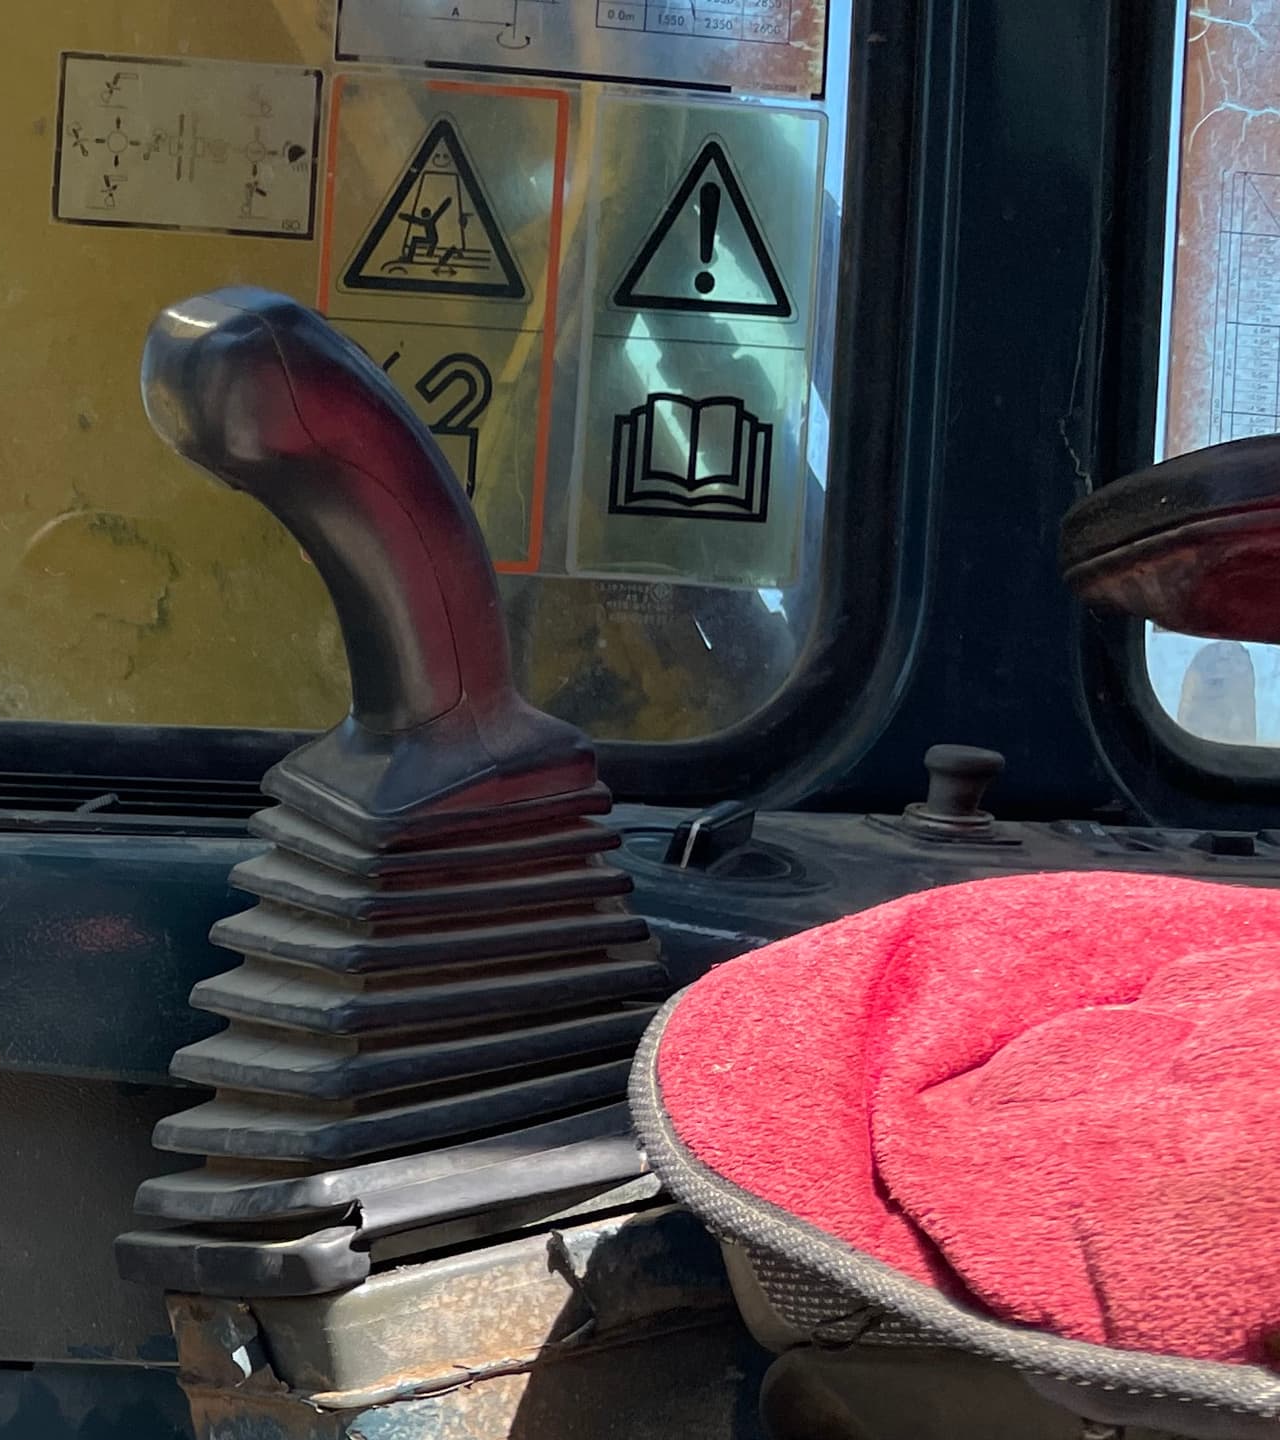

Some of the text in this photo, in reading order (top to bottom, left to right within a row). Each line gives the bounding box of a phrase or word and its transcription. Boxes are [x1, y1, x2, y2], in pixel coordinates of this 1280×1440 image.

[451, 6, 461, 17] A
[607, 9, 636, 21] 0.0m
[657, 14, 685, 27] 1550
[704, 17, 733, 31] 2350
